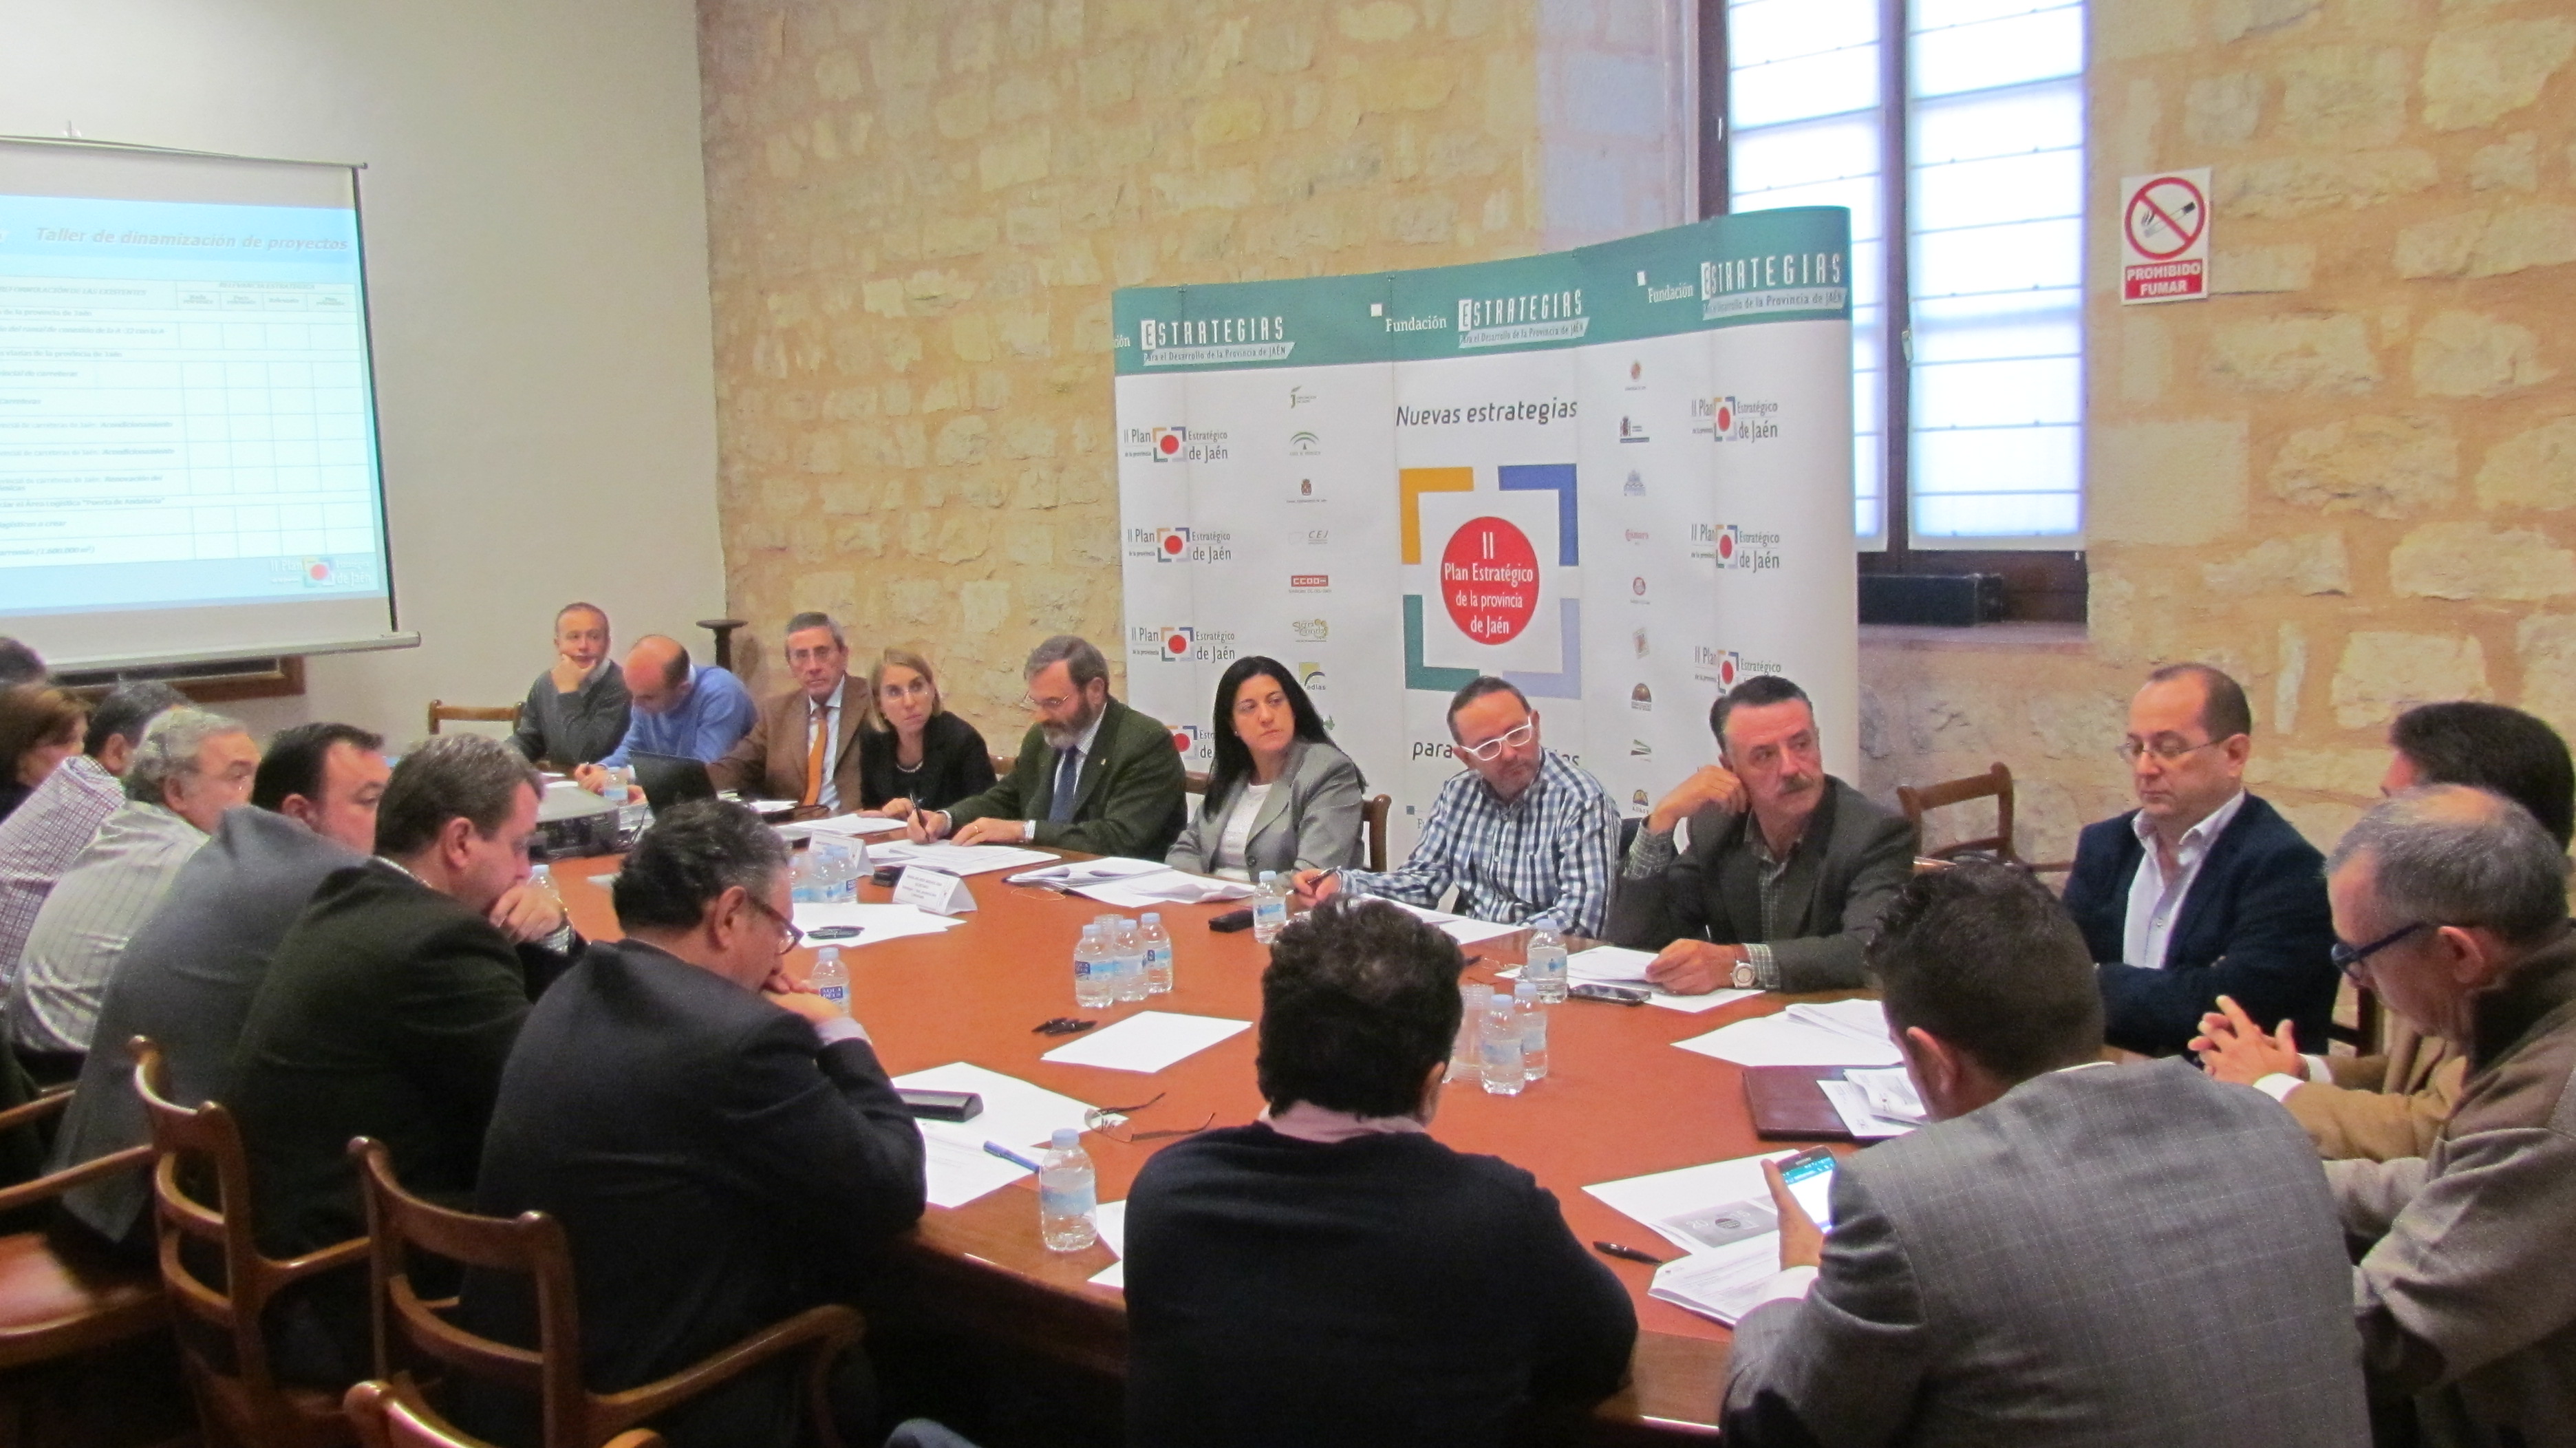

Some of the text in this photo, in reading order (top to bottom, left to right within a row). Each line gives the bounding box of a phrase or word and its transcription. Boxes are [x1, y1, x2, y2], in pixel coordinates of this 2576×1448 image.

[36, 227, 349, 252] Taller de dinamización de proyectos
[1648, 253, 1840, 303] Fundación ESTRATEGIAS
[2127, 263, 2201, 281] PROHIBIDO
[2140, 280, 2189, 296] FUMAR
[1766, 292, 1809, 306] Provincia
[1385, 289, 1582, 332] Fundación ESTRATEGIAS
[1144, 316, 1284, 348] ESTRATEGIAS
[1481, 330, 1510, 342] Desarrollo
[1512, 330, 1520, 339] de
[1521, 329, 1527, 339] la
[1529, 326, 1559, 338] Provincia
[1144, 343, 1287, 363] Para el Desarrollo de la Provincia de JAÉN
[1396, 397, 1578, 427] Nuevas estrategias
[1737, 401, 1778, 416] Estratégico
[1132, 428, 1151, 443] Plan
[1188, 430, 1227, 443] Estratégico
[1739, 420, 1778, 443] de Jaén
[1189, 445, 1228, 464] de Jaén
[1135, 529, 1155, 543] Plan
[1192, 531, 1230, 544] Estratégico
[1483, 532, 1494, 559] II
[1739, 531, 1779, 548] Estratégico
[1192, 546, 1232, 564] de Jaén
[1739, 551, 1780, 574] de Jaén
[1445, 562, 1533, 588] Plan Estratégico
[1456, 590, 1523, 612] de la provincia
[1139, 627, 1159, 641] Plan
[1196, 630, 1235, 643] Estratégico
[1470, 615, 1510, 638] de Jaén
[1196, 646, 1235, 663] de Jaén
[1741, 659, 1781, 676] Estratégico
[1200, 745, 1212, 758] de
[1413, 741, 1452, 760] para
